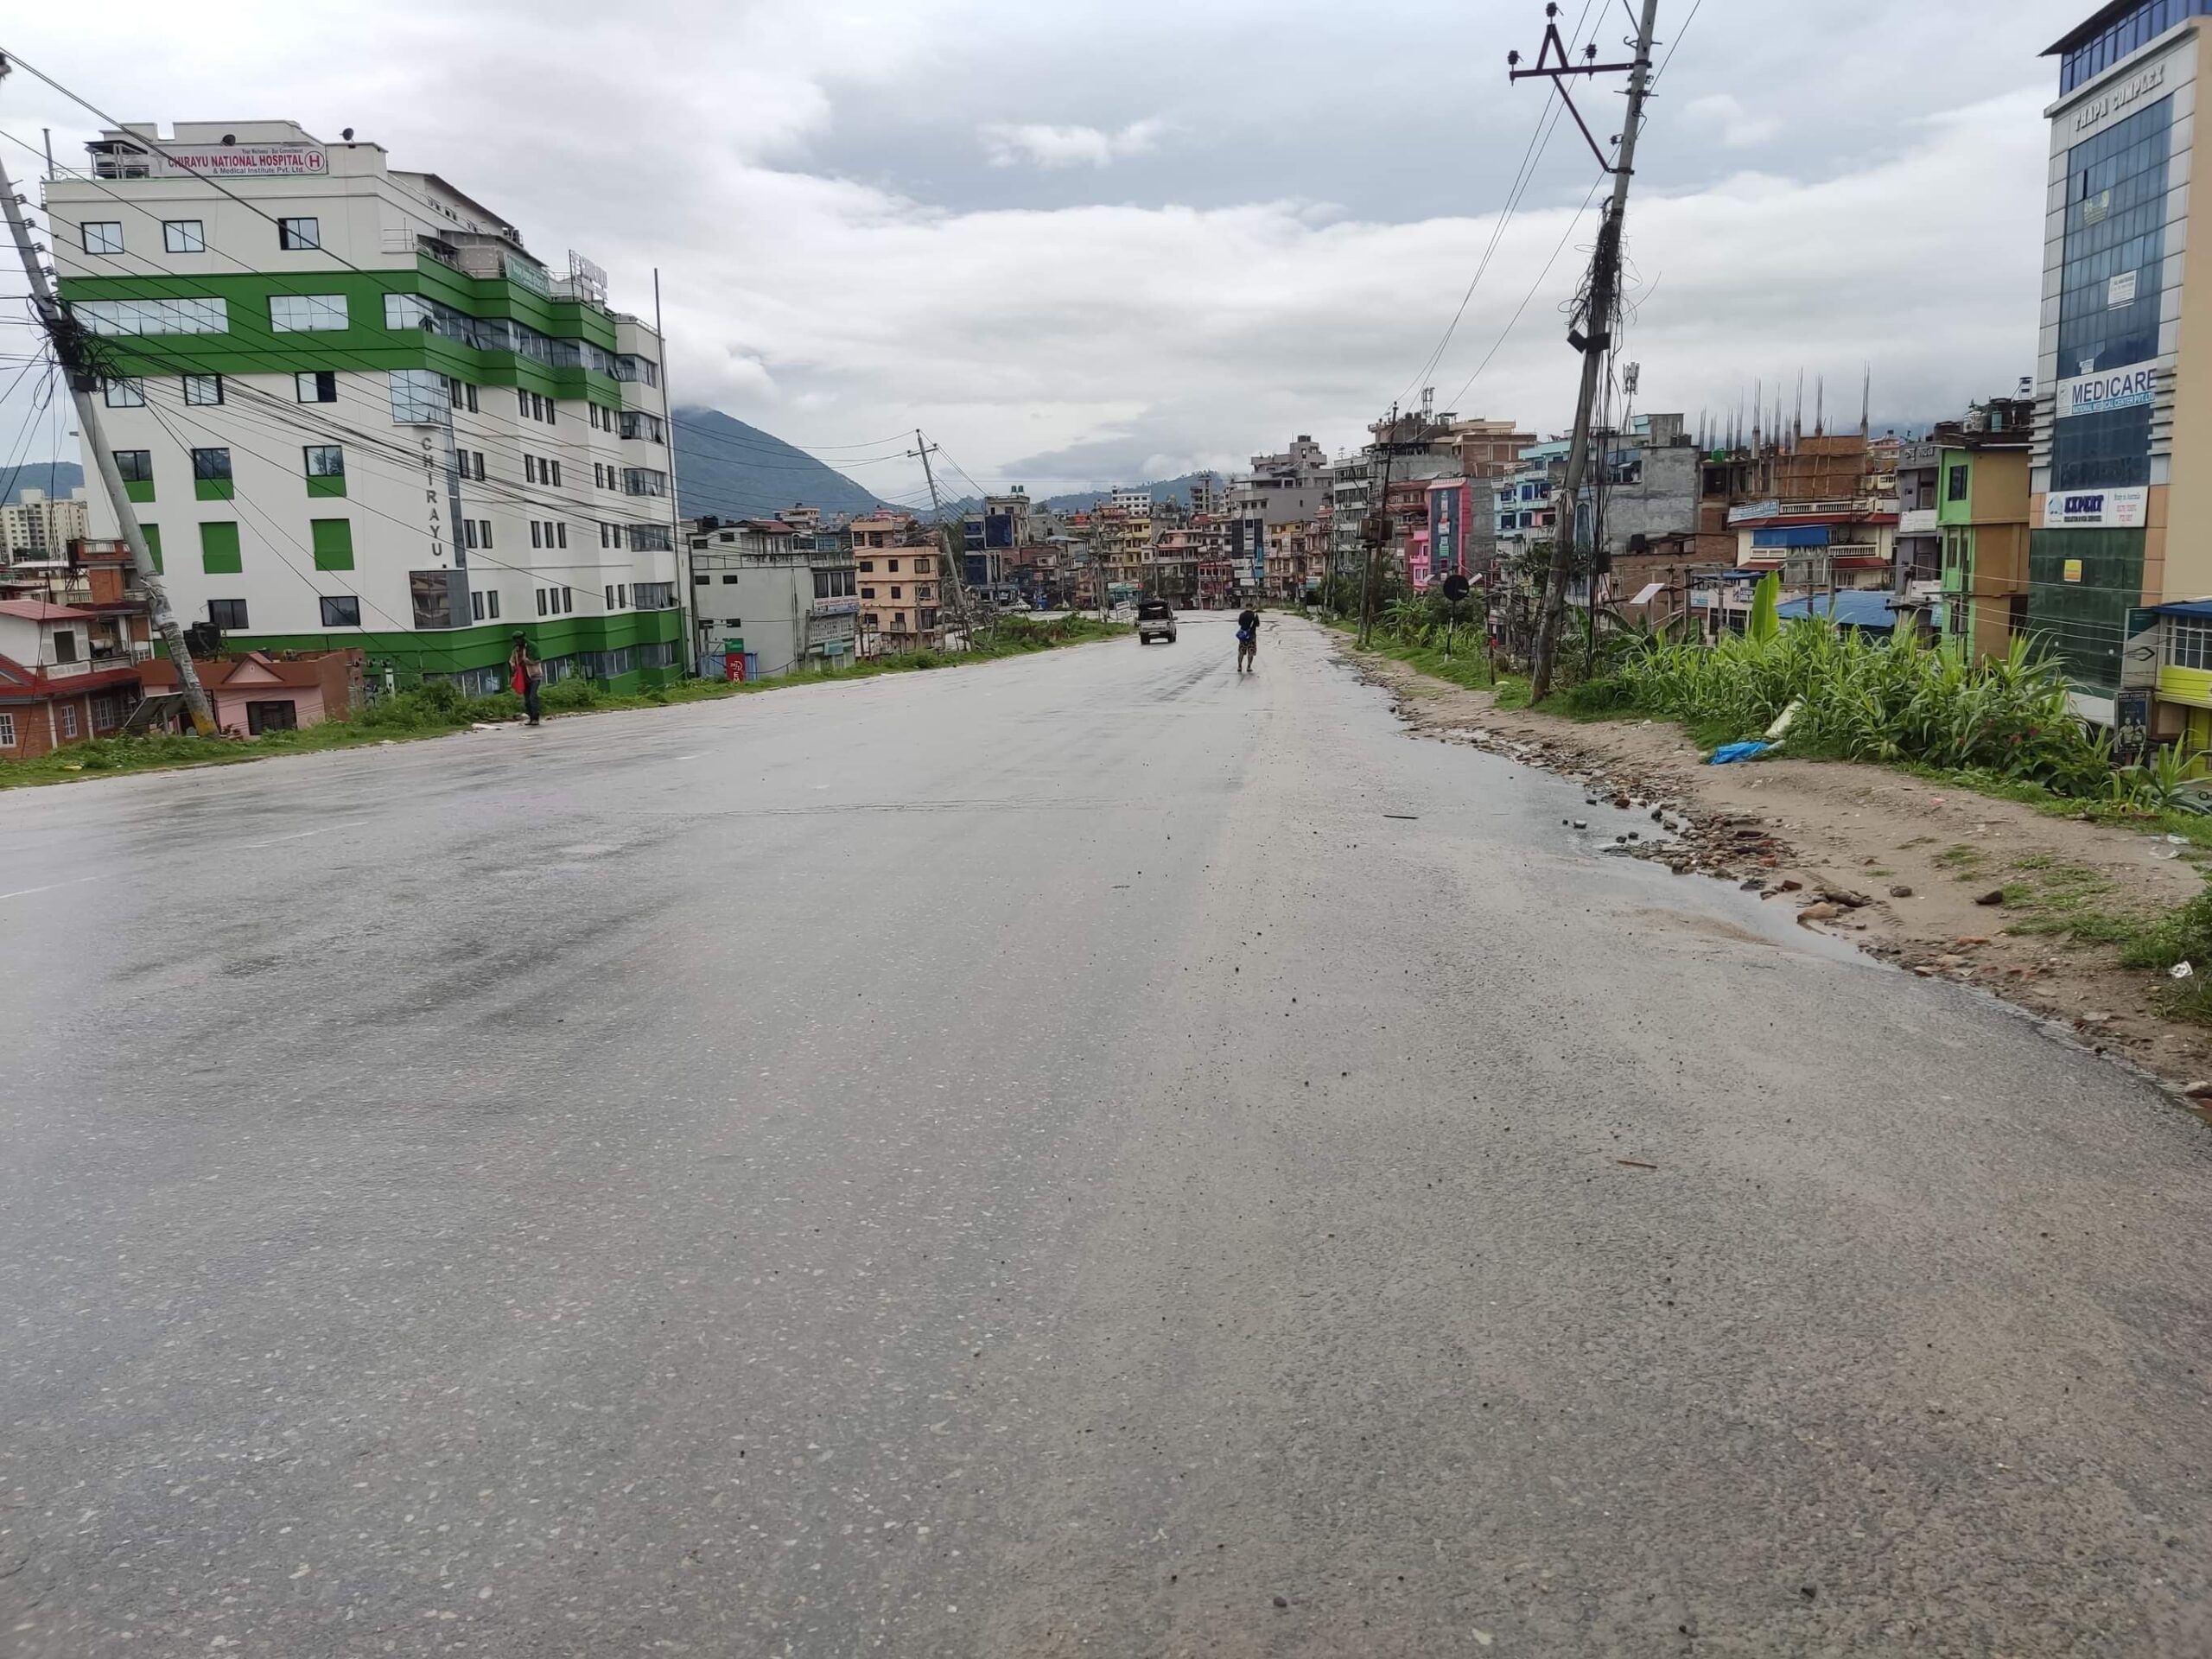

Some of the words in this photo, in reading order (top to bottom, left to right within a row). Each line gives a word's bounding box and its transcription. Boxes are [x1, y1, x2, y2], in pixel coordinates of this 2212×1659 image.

[2075, 98, 2107, 131] THAPA
[2113, 64, 2164, 111] COMPLEX
[168, 156, 208, 168] CHIRAYU
[211, 156, 257, 167] NATIONAL
[259, 154, 304, 166] HOSPITAL
[2072, 368, 2158, 404] MEDICARE
[2064, 495, 2103, 512] EXPERT
